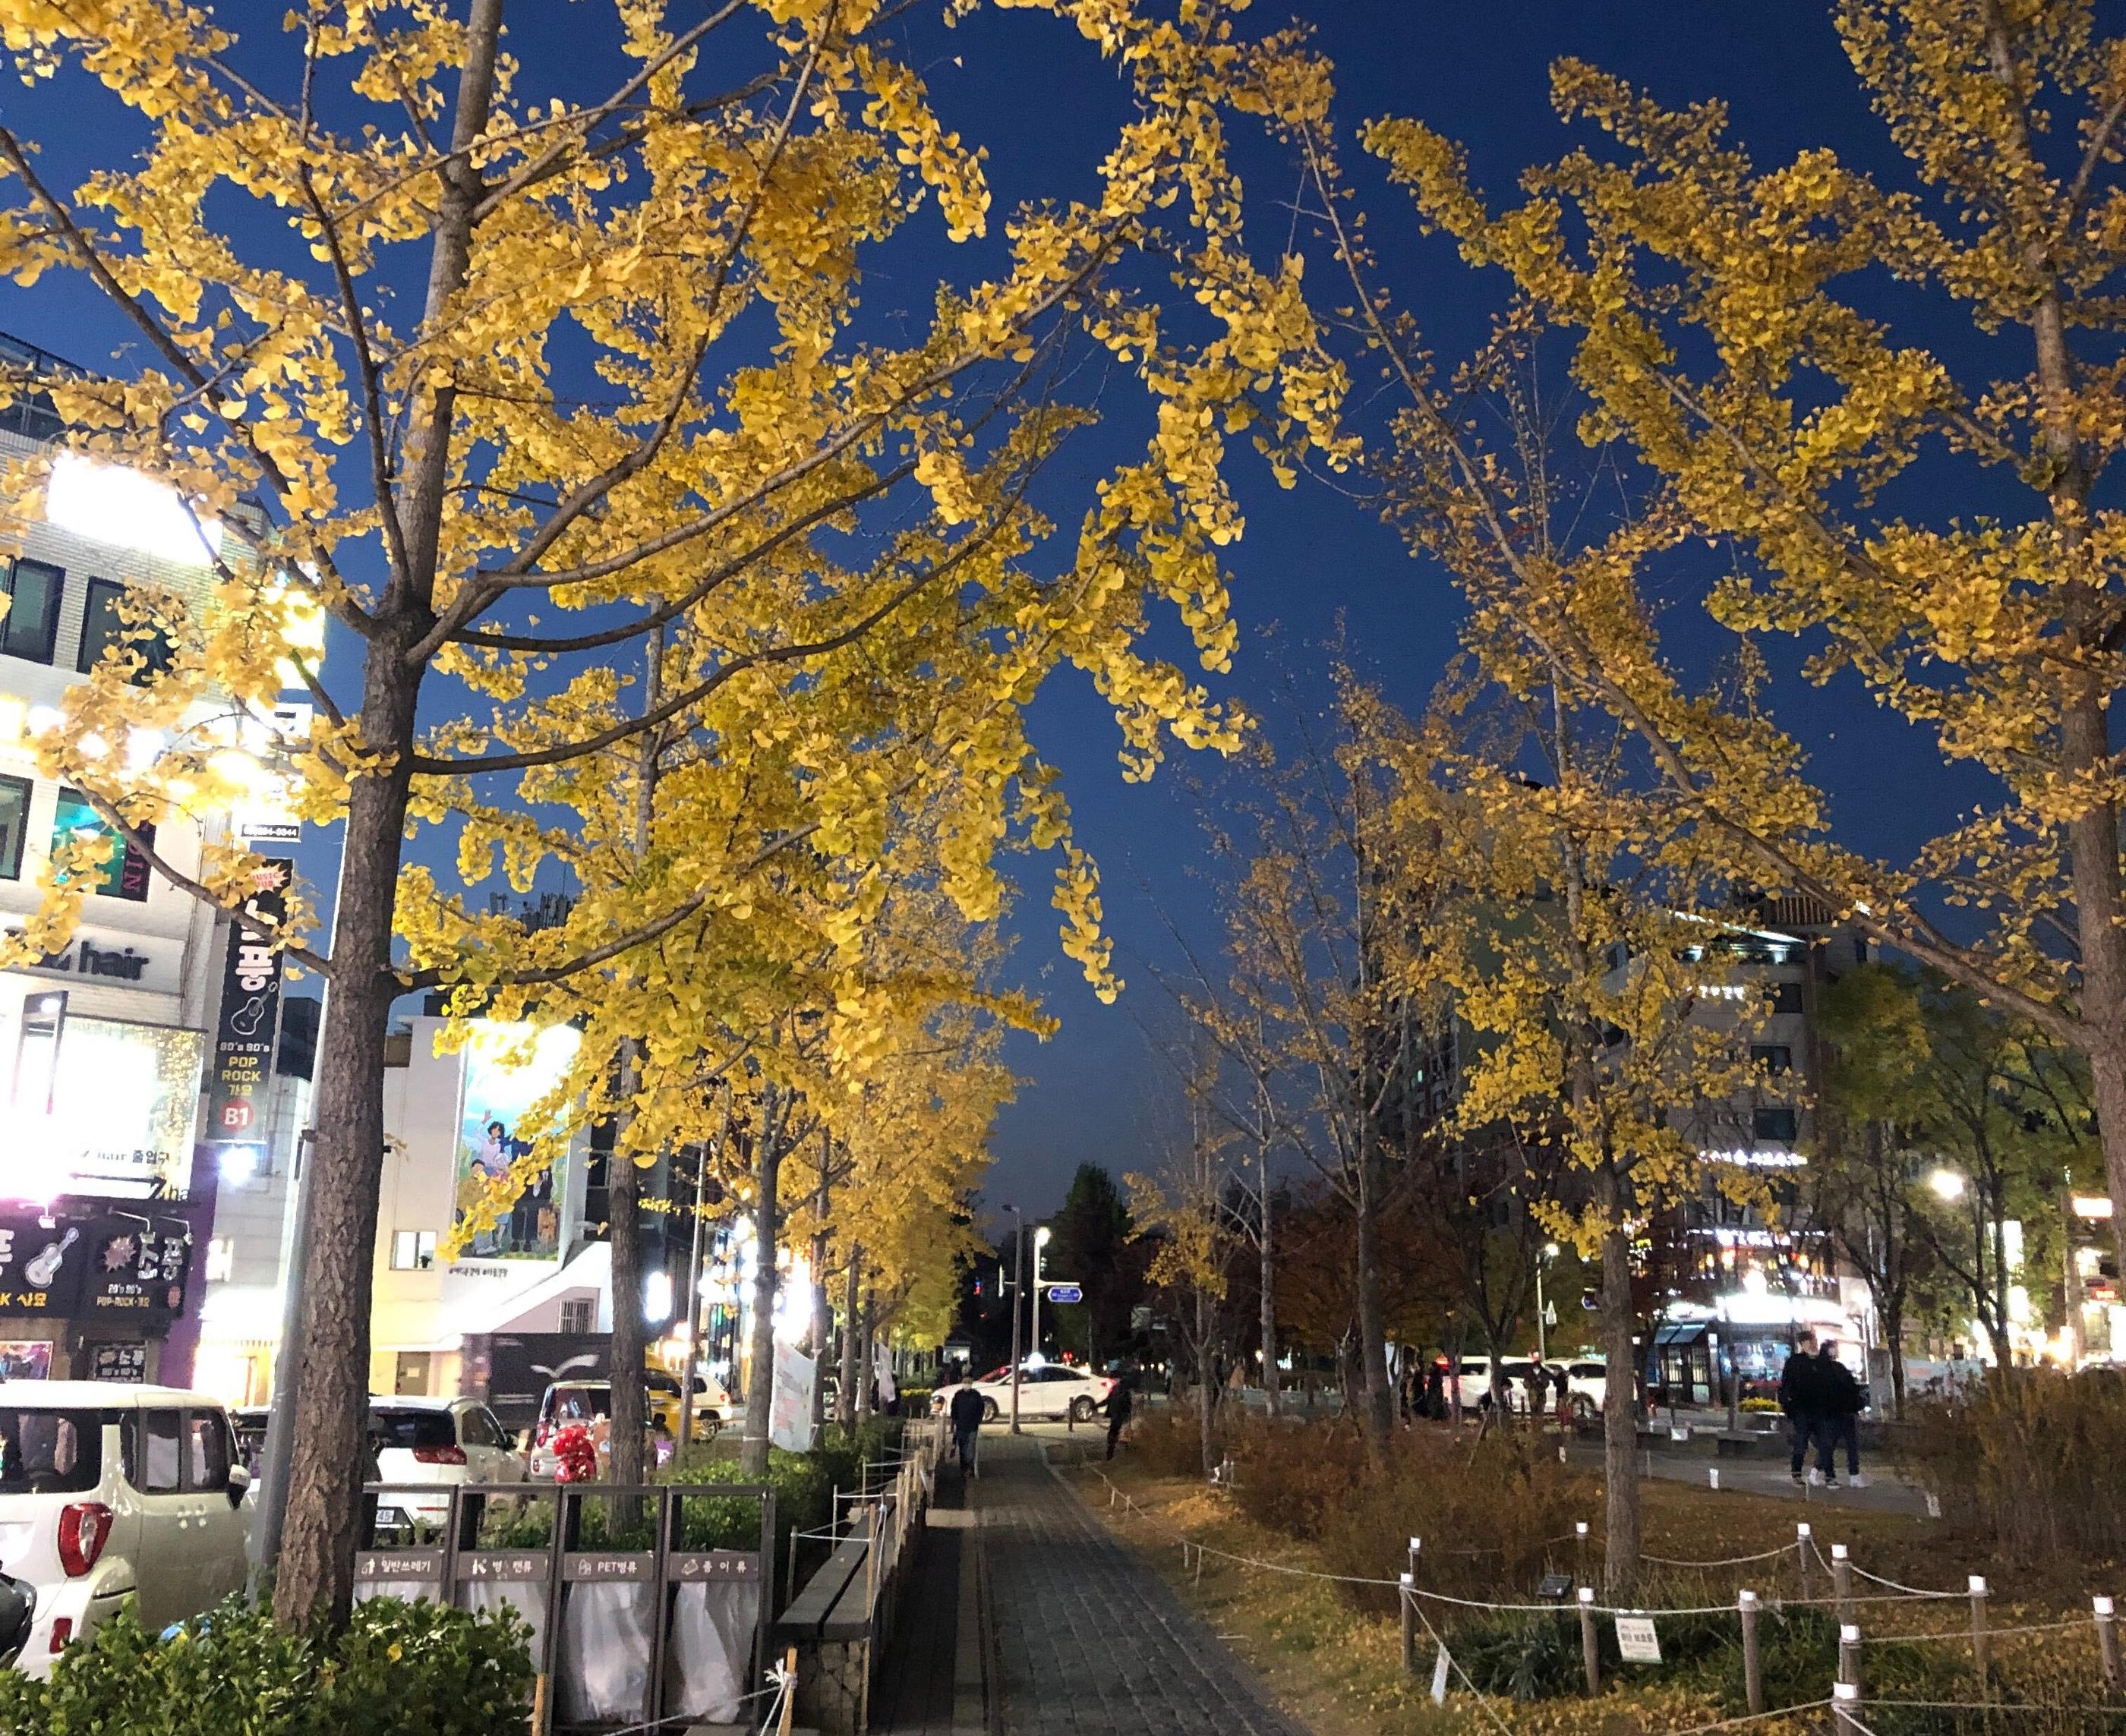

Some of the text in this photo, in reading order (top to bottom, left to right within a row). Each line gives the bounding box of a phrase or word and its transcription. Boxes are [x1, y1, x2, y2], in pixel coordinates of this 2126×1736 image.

[79, 940, 150, 980] hair
[229, 1056, 258, 1068] POP
[222, 1070, 261, 1082] ROCK
[224, 1107, 249, 1125] B1
[132, 1150, 169, 1165] 출입구
[381, 1559, 431, 1573] 일반쓰레기
